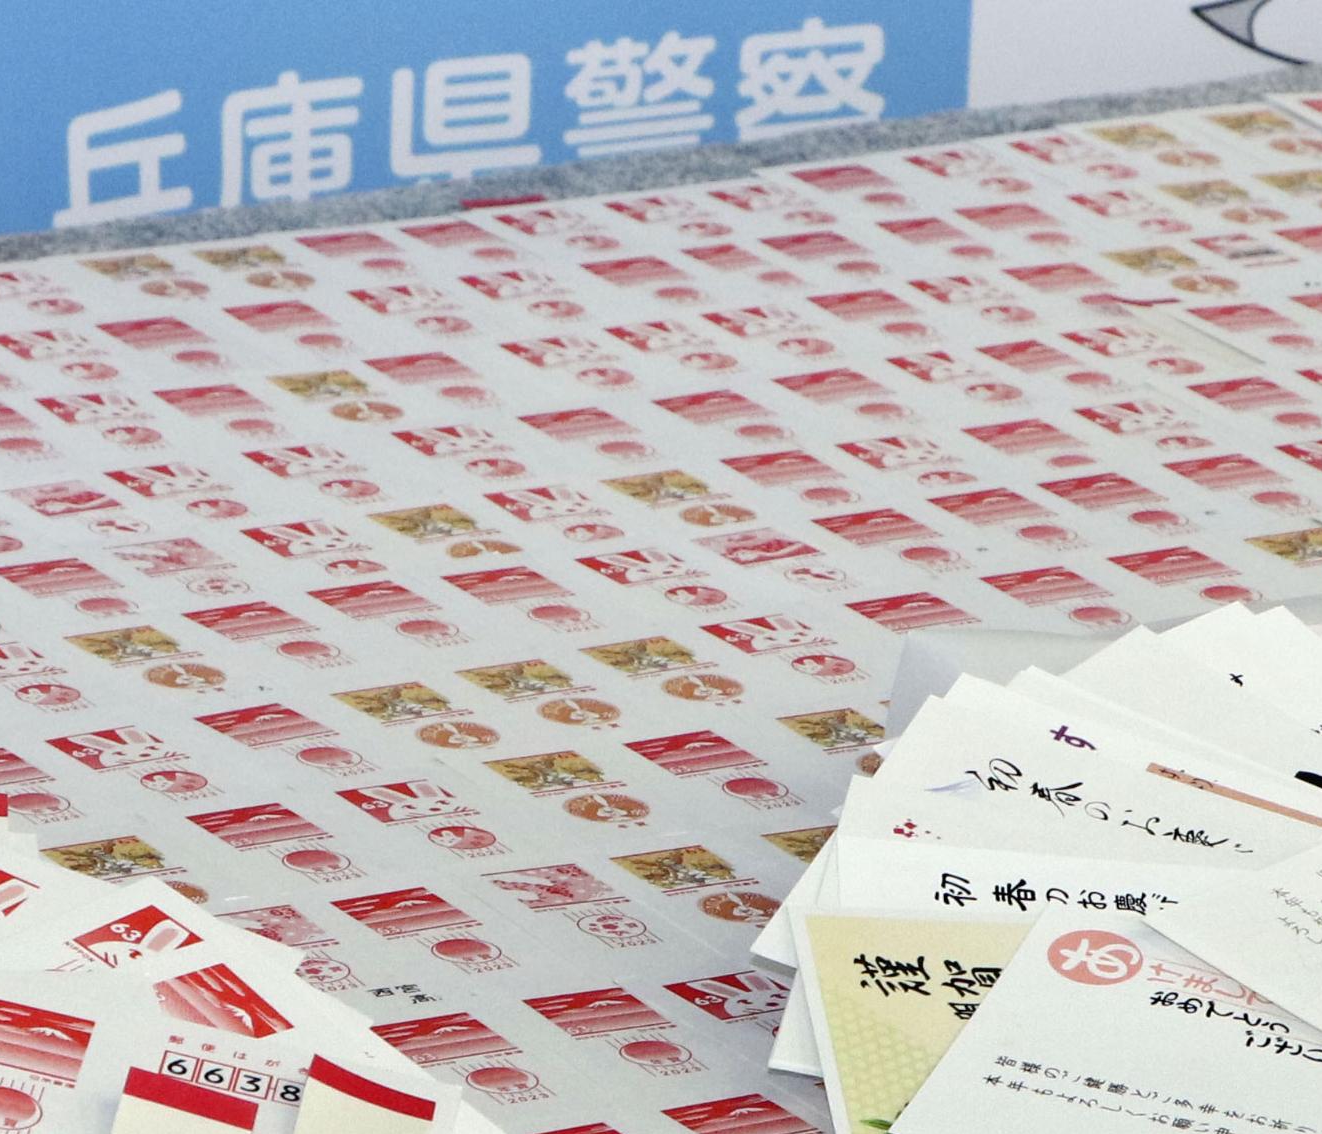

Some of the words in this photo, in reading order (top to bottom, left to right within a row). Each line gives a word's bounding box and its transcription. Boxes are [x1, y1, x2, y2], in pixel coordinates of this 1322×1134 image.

[53, 19, 887, 228] 兵庫県警察
[110, 923, 141, 943] 63
[64, 940, 96, 963] NIPPON
[693, 994, 720, 1007] 63
[167, 1058, 300, 1102] 6638
